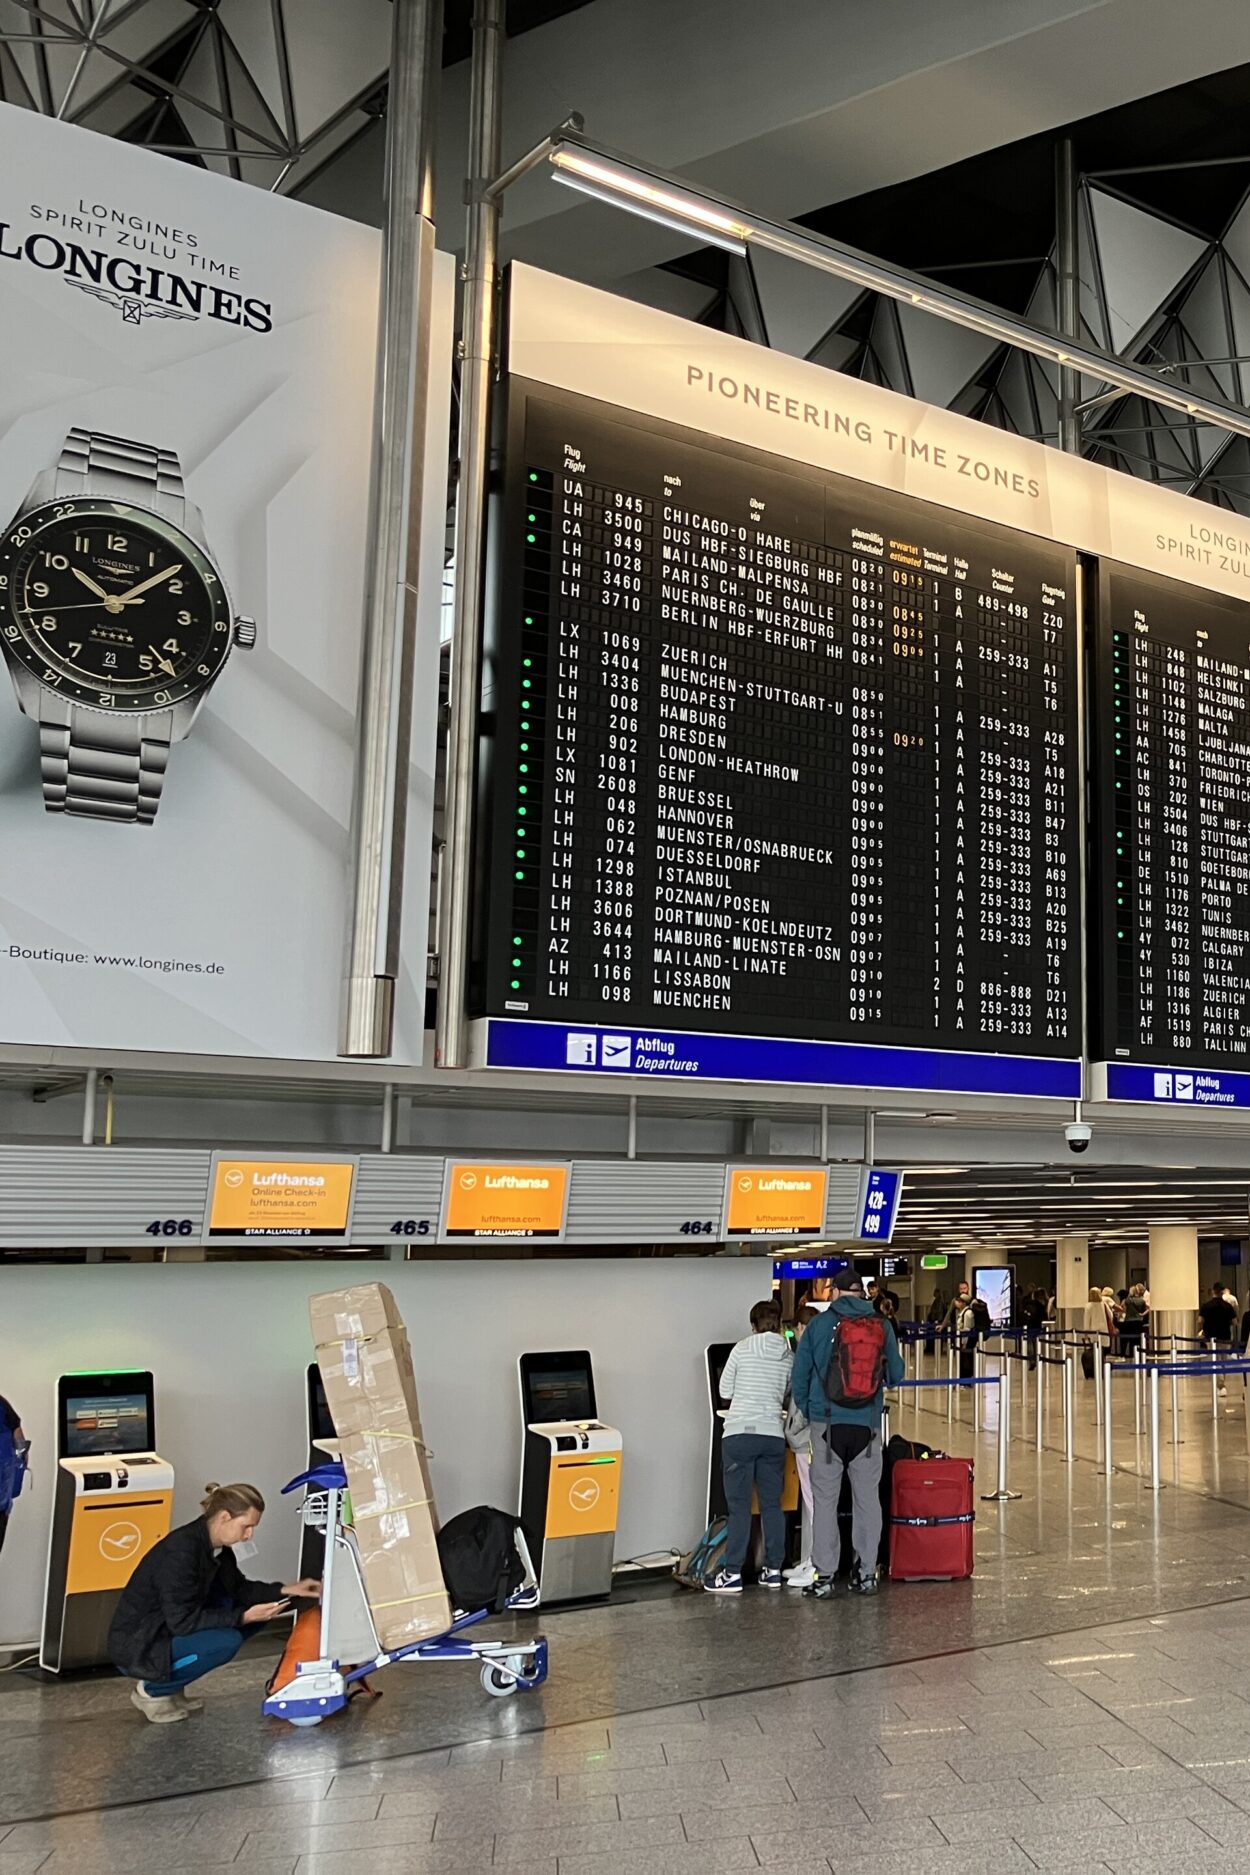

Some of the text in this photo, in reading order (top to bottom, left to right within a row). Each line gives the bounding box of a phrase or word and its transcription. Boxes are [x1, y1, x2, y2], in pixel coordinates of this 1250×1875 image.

[79, 199, 198, 247] LONGINES
[30, 205, 241, 280] SPIRIT ZULU TIME
[0, 222, 272, 333] LONGINES
[687, 364, 1040, 498] PIONEERING TIME ZONES
[564, 444, 580, 460] Flug
[663, 475, 681, 486] nach
[563, 458, 585, 472] Flight
[663, 487, 672, 496] to
[107, 534, 128, 553] 12
[564, 479, 1062, 629] UA 945 CHICAGO-O HARE 489-498 Z20
[604, 510, 842, 585] 3500 DUS HBF-SIEGBURG HBF
[1156, 534, 1211, 566] SPIRIT
[45, 552, 70, 570] 10
[92, 556, 141, 572] LONGINES
[614, 532, 808, 595] 949 MAILAND-MALPENSA
[662, 564, 709, 589] PARIS
[756, 588, 772, 605] DE
[783, 595, 833, 620] GAULLE
[662, 584, 834, 639] NUERNBERG-WUERZBURG
[662, 604, 842, 659] BERLIN HBF-ERFURT HH
[560, 621, 726, 671] LX 1069 ZUERICH
[602, 671, 736, 711] 1336 BUDAPEST
[661, 663, 842, 715] MUENCHEN-STUTTGART-U
[1197, 671, 1243, 693] HELSINKI
[1198, 686, 1245, 709] SALZBURG
[660, 703, 726, 729] HAMBURG
[659, 723, 726, 749] DRESDEN
[1199, 734, 1250, 756] LJUBLJANA
[659, 744, 799, 781] LONDON-HEATHROW
[1198, 749, 1250, 772] CHARLOTTE
[658, 763, 695, 782] GENF
[555, 767, 733, 810] SN 2608 BRUESSEL
[658, 804, 733, 829] HANNOVER
[657, 825, 832, 864] MUENSTER/OSNABRUECK
[656, 845, 760, 872] DUESSELDORF
[596, 857, 731, 889] 1298 ISTANBUL
[655, 886, 769, 914] POZNAN/POSEN
[1201, 892, 1231, 908] PORTO
[655, 906, 832, 941] DORTMUND-KOELNDEUTZ
[1201, 908, 1231, 924] TUNIS
[654, 927, 840, 961] HAMBURG-MUENSTER-OSN
[1202, 940, 1244, 956] CALGARY
[94, 956, 225, 974] www.longines.de
[548, 937, 1066, 1002] AZ 413 MAILAND-LINATE 886-888 D21
[1204, 957, 1233, 971] IBIZA
[593, 963, 730, 989] 1166 LISSABON
[1202, 973, 1250, 989] VALENCIA
[602, 985, 730, 1010] 098 MUENCHEN
[1203, 989, 1245, 1005] ZUERICH
[1203, 1005, 1239, 1020] ALGIER
[636, 1037, 675, 1055] Abflug
[1204, 1038, 1246, 1053] TALLINN
[635, 1055, 699, 1072] Departures
[1195, 1075, 1220, 1090] Abflug
[1195, 1089, 1235, 1103] Departures
[252, 1172, 326, 1187] Lufthansa
[484, 1175, 549, 1189] Lufthansa
[758, 1179, 812, 1191] Lufthansa
[249, 1198, 317, 1208] lufthansa.com
[251, 1188, 326, 1198] Online Check-in
[145, 1219, 193, 1237] 466
[390, 1220, 430, 1236] 465
[481, 1214, 541, 1224] lufthansa.com
[679, 1221, 713, 1235] 464
[756, 1214, 806, 1223] lufthansa.com
[864, 1214, 881, 1233] 499
[266, 1228, 302, 1236] ALLIANCE
